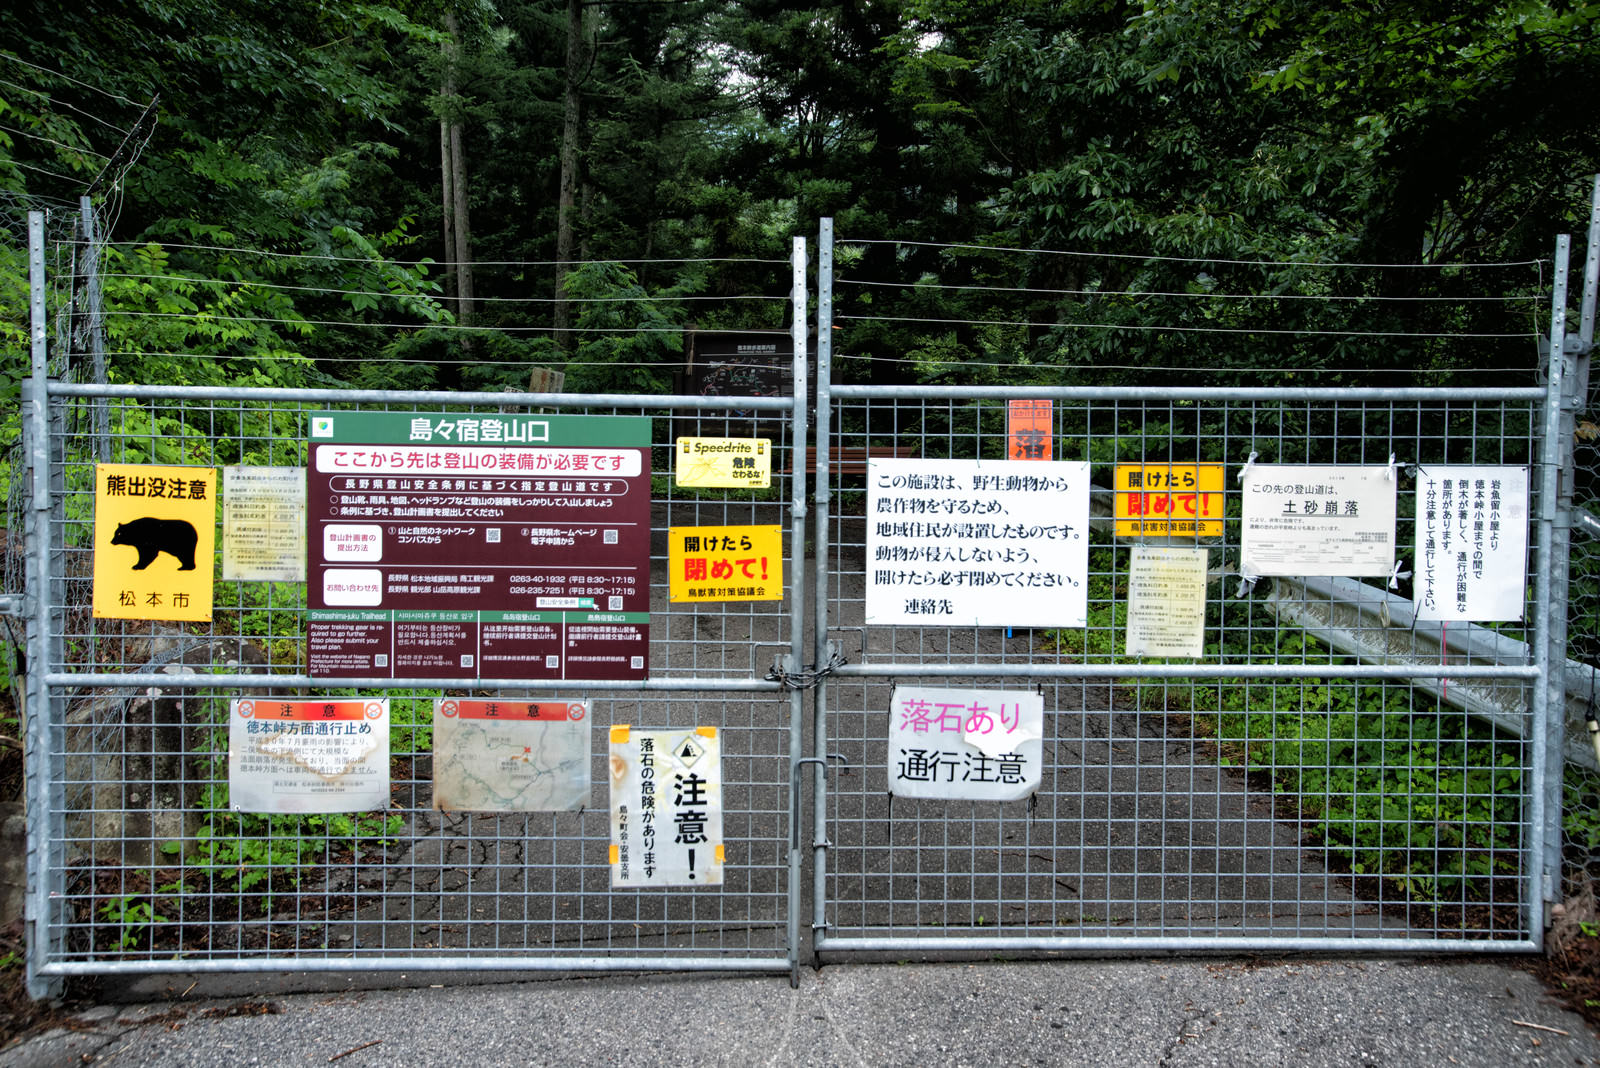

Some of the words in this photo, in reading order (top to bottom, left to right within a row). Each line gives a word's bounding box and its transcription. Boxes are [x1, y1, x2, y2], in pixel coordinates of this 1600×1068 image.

[409, 418, 549, 442] 島々宿登山口
[694, 442, 751, 455] Speedrite
[334, 452, 625, 471] ここから先は登山の装備が必要です
[732, 457, 755, 468] 危険
[107, 475, 207, 500] 熊出没注意
[345, 479, 613, 492] 長野県登山安全条例に基づく指定登山道です
[878, 474, 1068, 492] この施設は、野生動物から
[1128, 472, 1195, 487] 開けたら
[1252, 484, 1339, 495] この先の登山道は、
[340, 507, 503, 518] 条例に基づき、登山計画書を提出してください
[877, 498, 1010, 515] 農作物を守るため、
[1128, 492, 1209, 516] 閉めて!
[1283, 500, 1359, 514] 土砂崩落
[1442, 480, 1453, 555] 箇所があります。
[1490, 480, 1501, 551] 岩魚留小屋より
[329, 534, 377, 542] 登山計画書の
[398, 527, 475, 535] 山と自然のネットワーク
[531, 528, 597, 537] 長野県ホームページ
[876, 522, 1079, 540] 地域住民が設置したものです。
[1472, 480, 1485, 579] 徳本峠小屋までの間で
[337, 543, 369, 552] 提出方法
[398, 536, 441, 544] コンパスから
[531, 537, 575, 545] 電子申請から
[684, 536, 752, 553] 開けたら
[1425, 479, 1437, 612] 十分注意して通行して下さい。
[1456, 480, 1469, 613] 倒木が著しく、通行が困難な
[875, 545, 1038, 563] 動物が侵入しないよう、
[684, 557, 768, 581] 閉めて!
[875, 570, 1079, 588] 開けたら必ず閉めてください。
[326, 584, 379, 593] お問い合わせ先
[688, 587, 766, 597] 鳥獣害対策協議会
[118, 590, 190, 608] 松本市
[904, 598, 953, 615] 連絡先
[280, 704, 336, 718] 注意
[486, 704, 540, 718] 注意
[899, 699, 1020, 734] 落石あり
[246, 721, 372, 735] 徳本峠方面通行止め
[897, 749, 1027, 784] 通行注意
[640, 738, 656, 878] 落石の危険があります
[674, 773, 708, 880] 注意!
